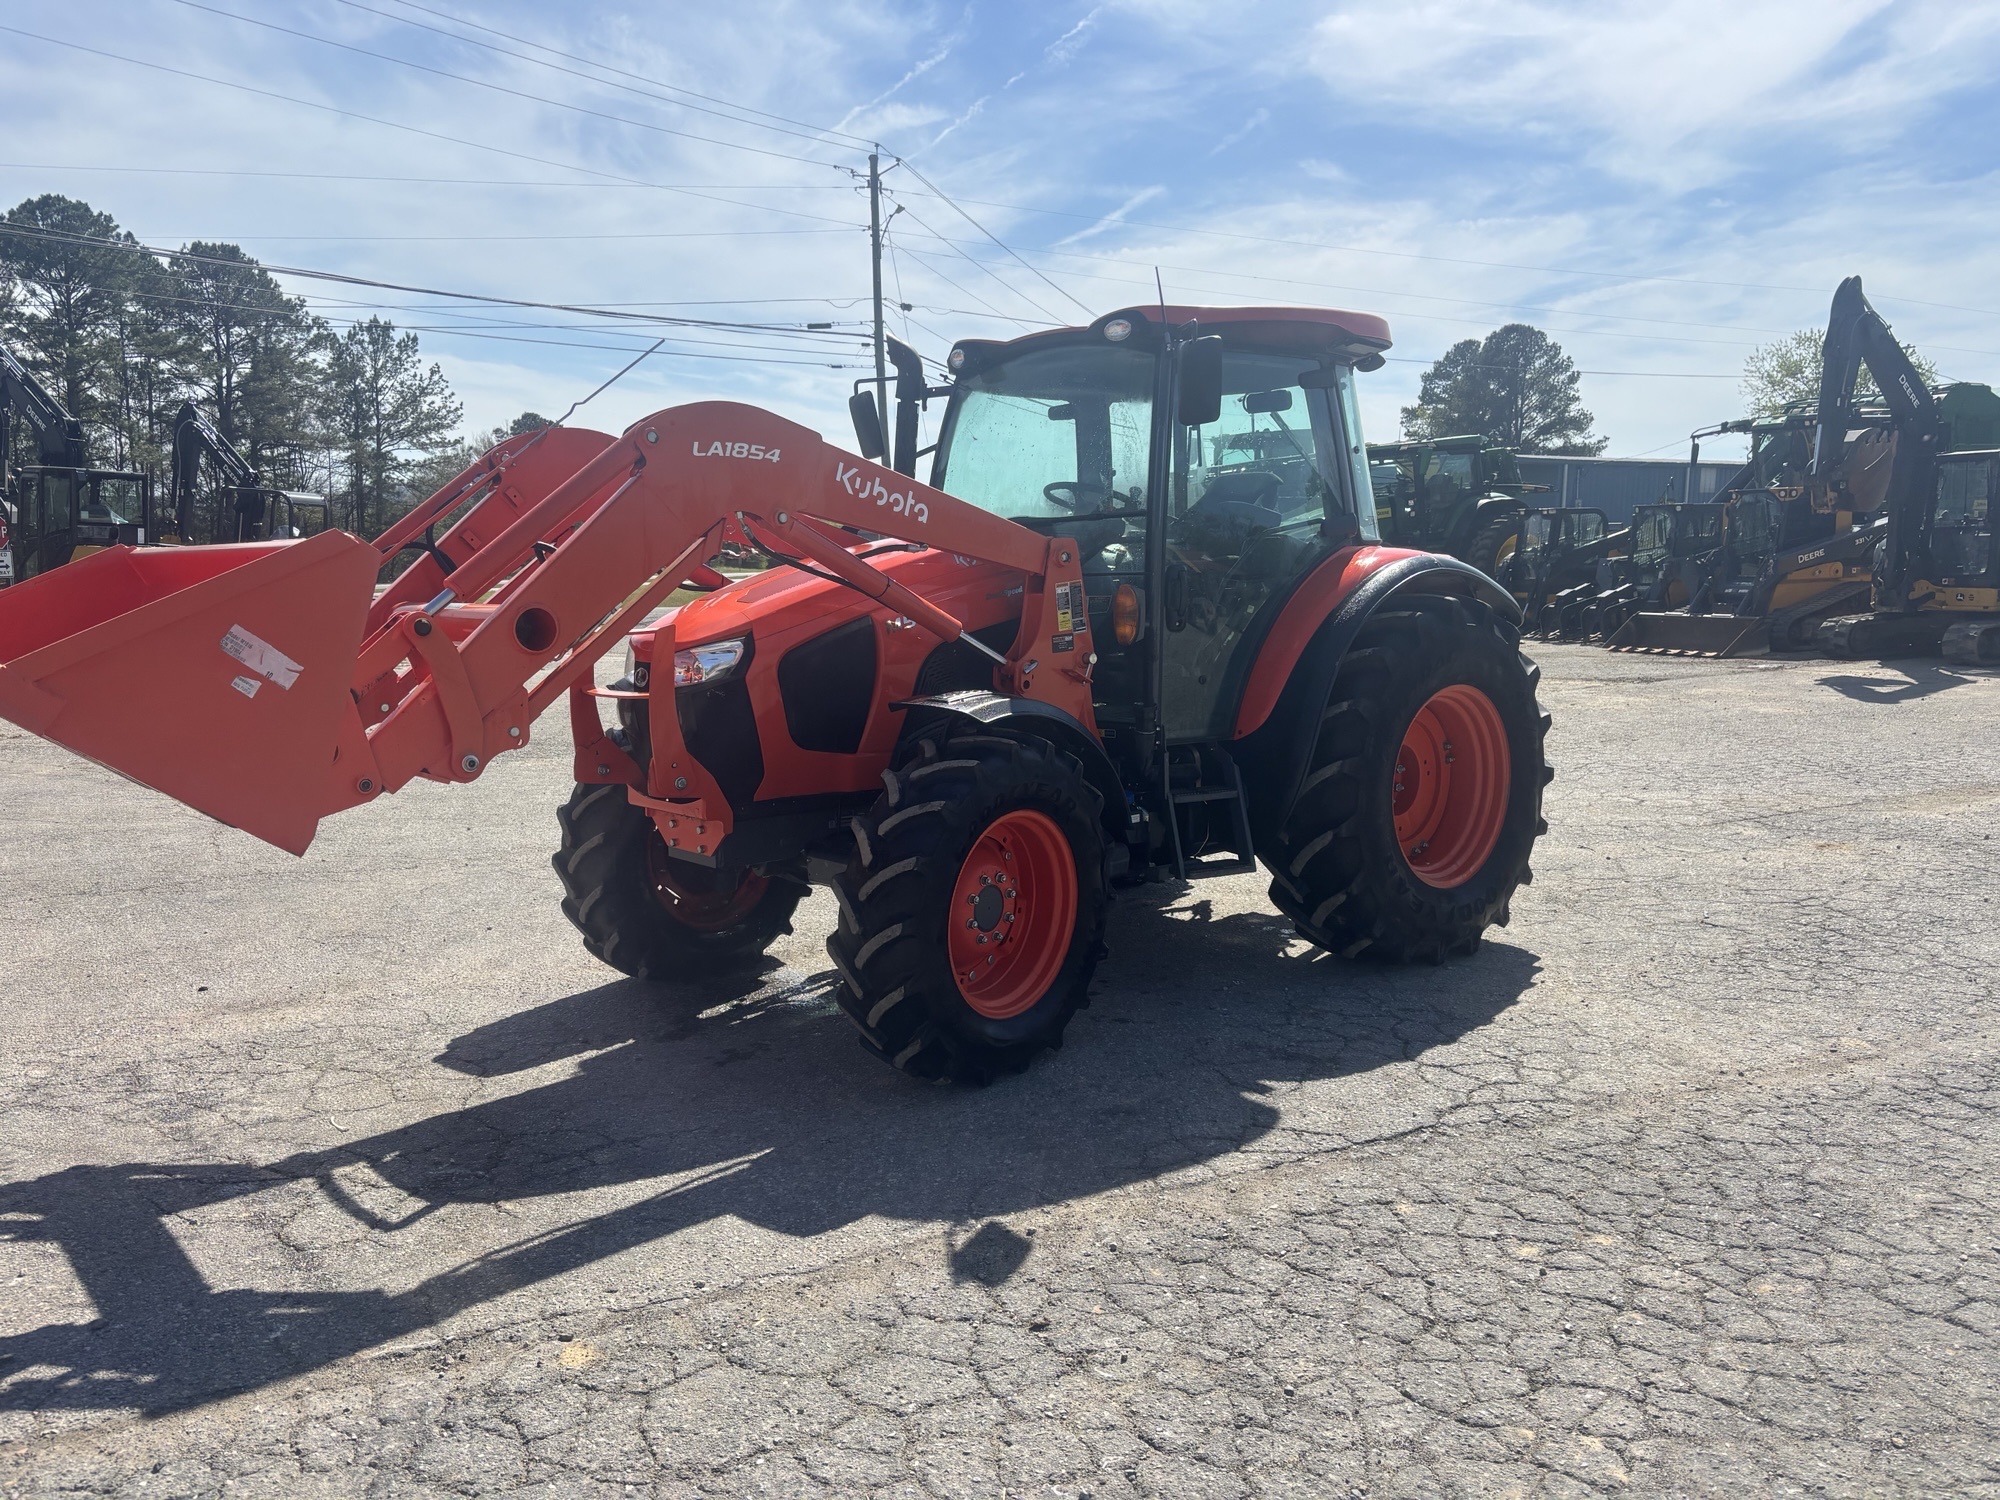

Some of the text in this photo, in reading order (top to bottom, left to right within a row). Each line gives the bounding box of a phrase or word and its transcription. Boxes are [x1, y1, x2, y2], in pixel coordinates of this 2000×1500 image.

[1899, 374, 1920, 408] DEERE
[26, 404, 47, 431] DEERE
[693, 441, 781, 463] LA1854
[836, 461, 929, 523] Kubota
[1798, 548, 1825, 563] DEERE
